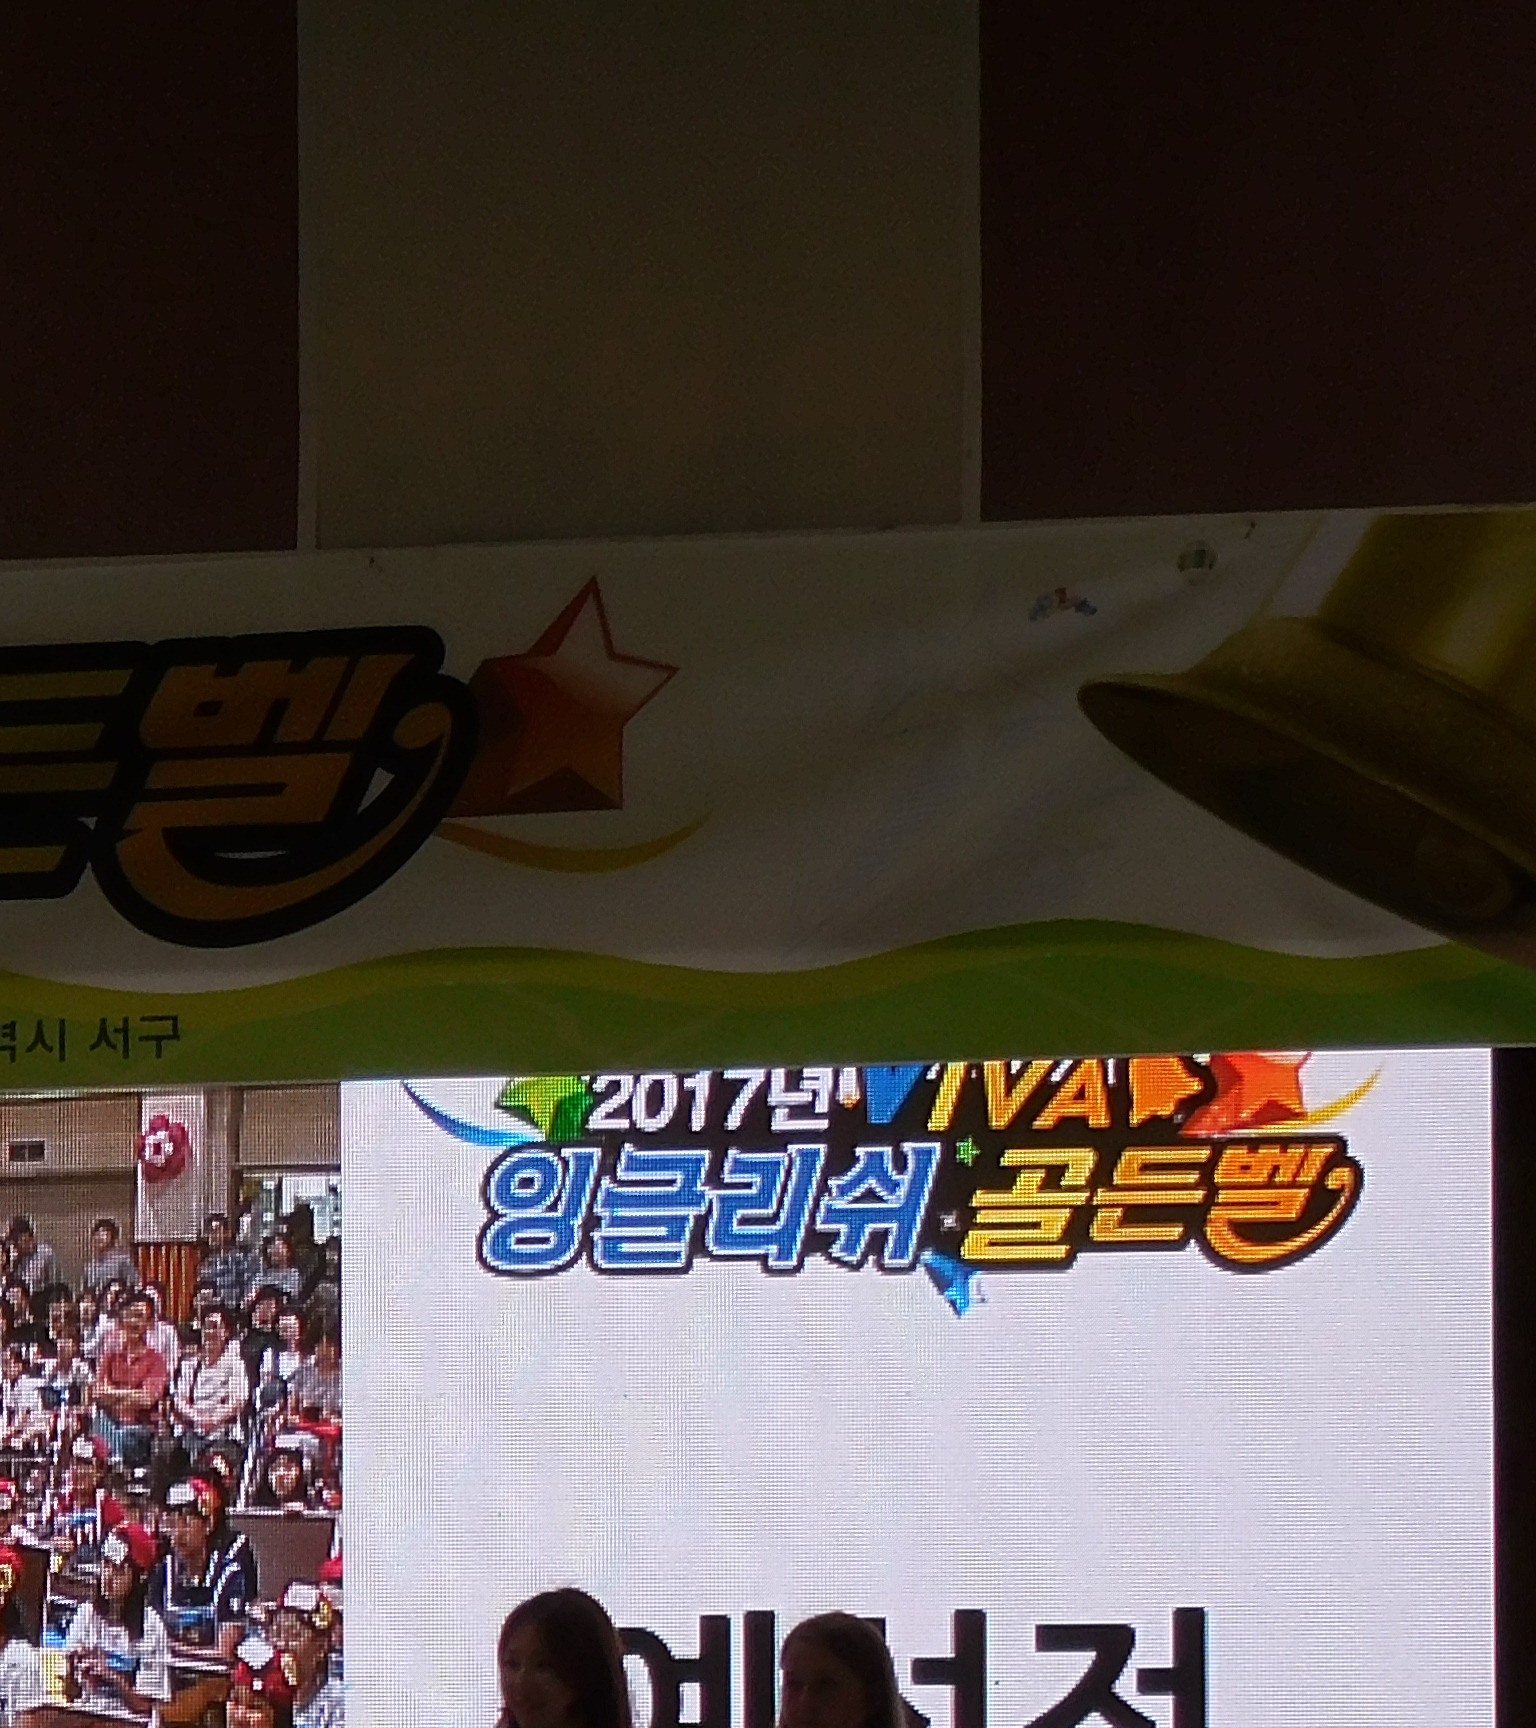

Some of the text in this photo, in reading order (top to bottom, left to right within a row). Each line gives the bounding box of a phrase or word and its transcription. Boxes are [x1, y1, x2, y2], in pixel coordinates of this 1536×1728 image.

[88, 1013, 182, 1063] 서구
[584, 1066, 834, 1134] 2017년
[478, 1134, 1364, 1275] 잉글리쉬 골든벨
